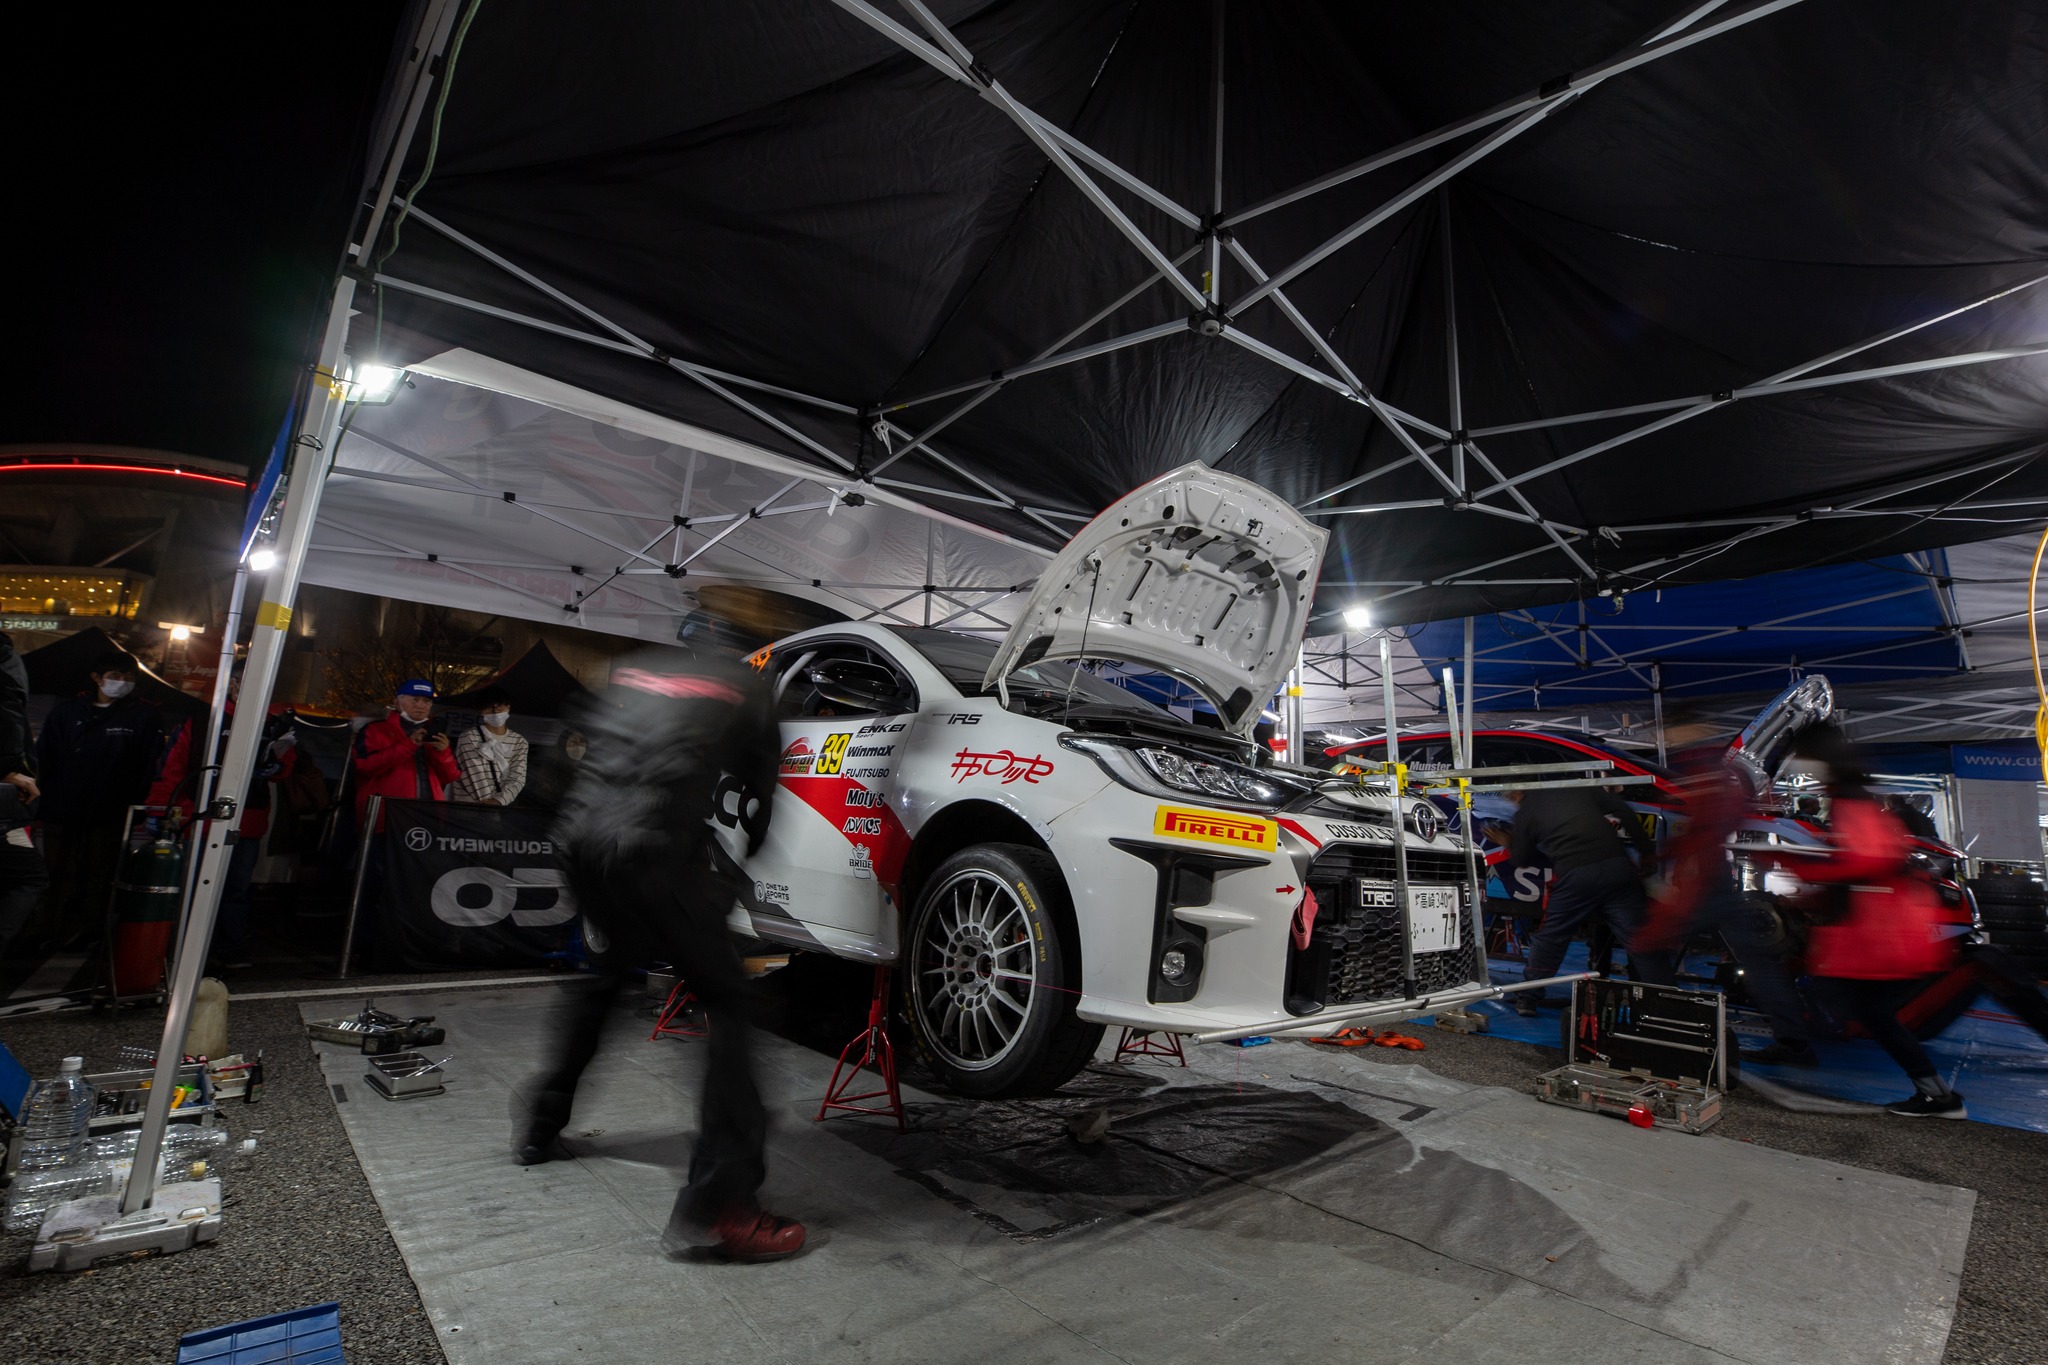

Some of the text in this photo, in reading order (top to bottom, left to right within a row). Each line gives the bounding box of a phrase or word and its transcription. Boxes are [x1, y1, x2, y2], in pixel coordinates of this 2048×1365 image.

[858, 724, 907, 734] ENKEI
[817, 734, 851, 774] 39
[1409, 760, 1452, 771] Munster
[845, 768, 889, 778] FUJITSUBO
[847, 789, 885, 808] Moty's
[1164, 811, 1267, 844] PIRELLI
[1325, 824, 1374, 839] CUSCO
[849, 859, 873, 869] BRIDE
[766, 882, 777, 890] ONE
[766, 890, 790, 901] SPORTS
[1363, 890, 1394, 905] TRD
